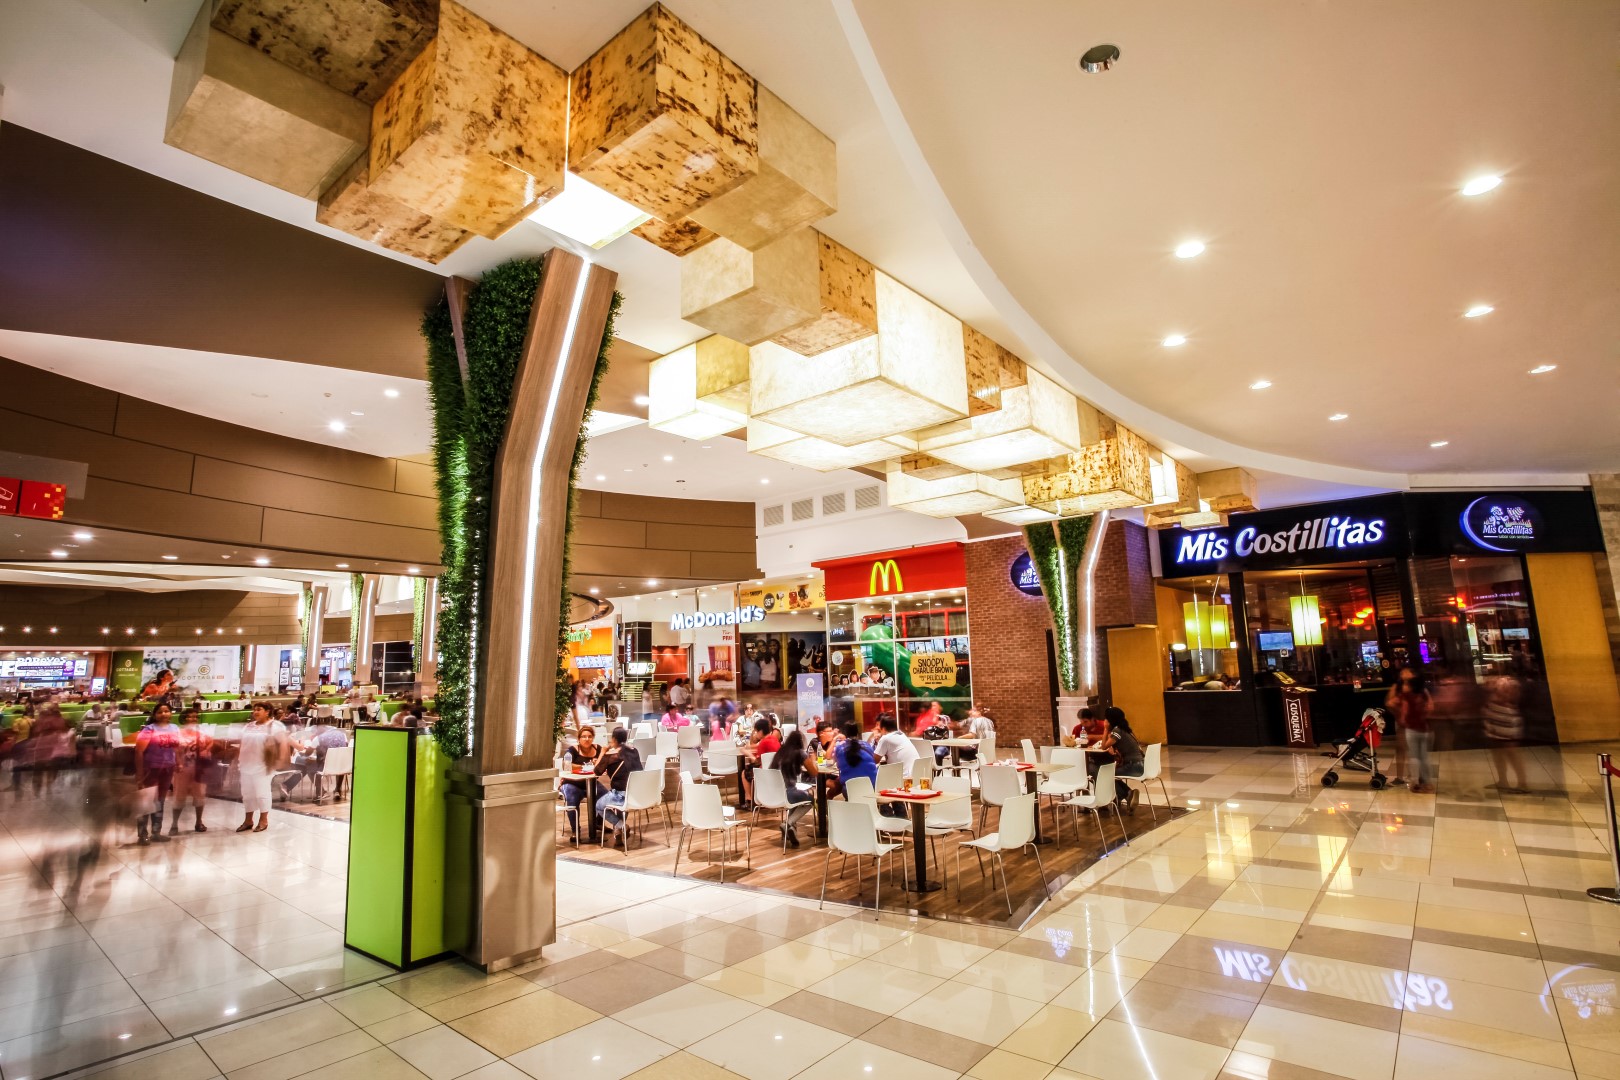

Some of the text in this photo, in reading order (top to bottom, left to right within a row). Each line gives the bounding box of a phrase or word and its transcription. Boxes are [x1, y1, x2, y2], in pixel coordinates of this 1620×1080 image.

[1483, 524, 1533, 535] Mis Costillitas
[1176, 516, 1385, 563] Mis Costillitas
[1020, 576, 1032, 584] Mis
[670, 605, 766, 630] McDonald's
[917, 658, 945, 667] SNOOPY
[934, 666, 954, 674] BROWN
[1289, 703, 1303, 739] CUSQUEÑA
